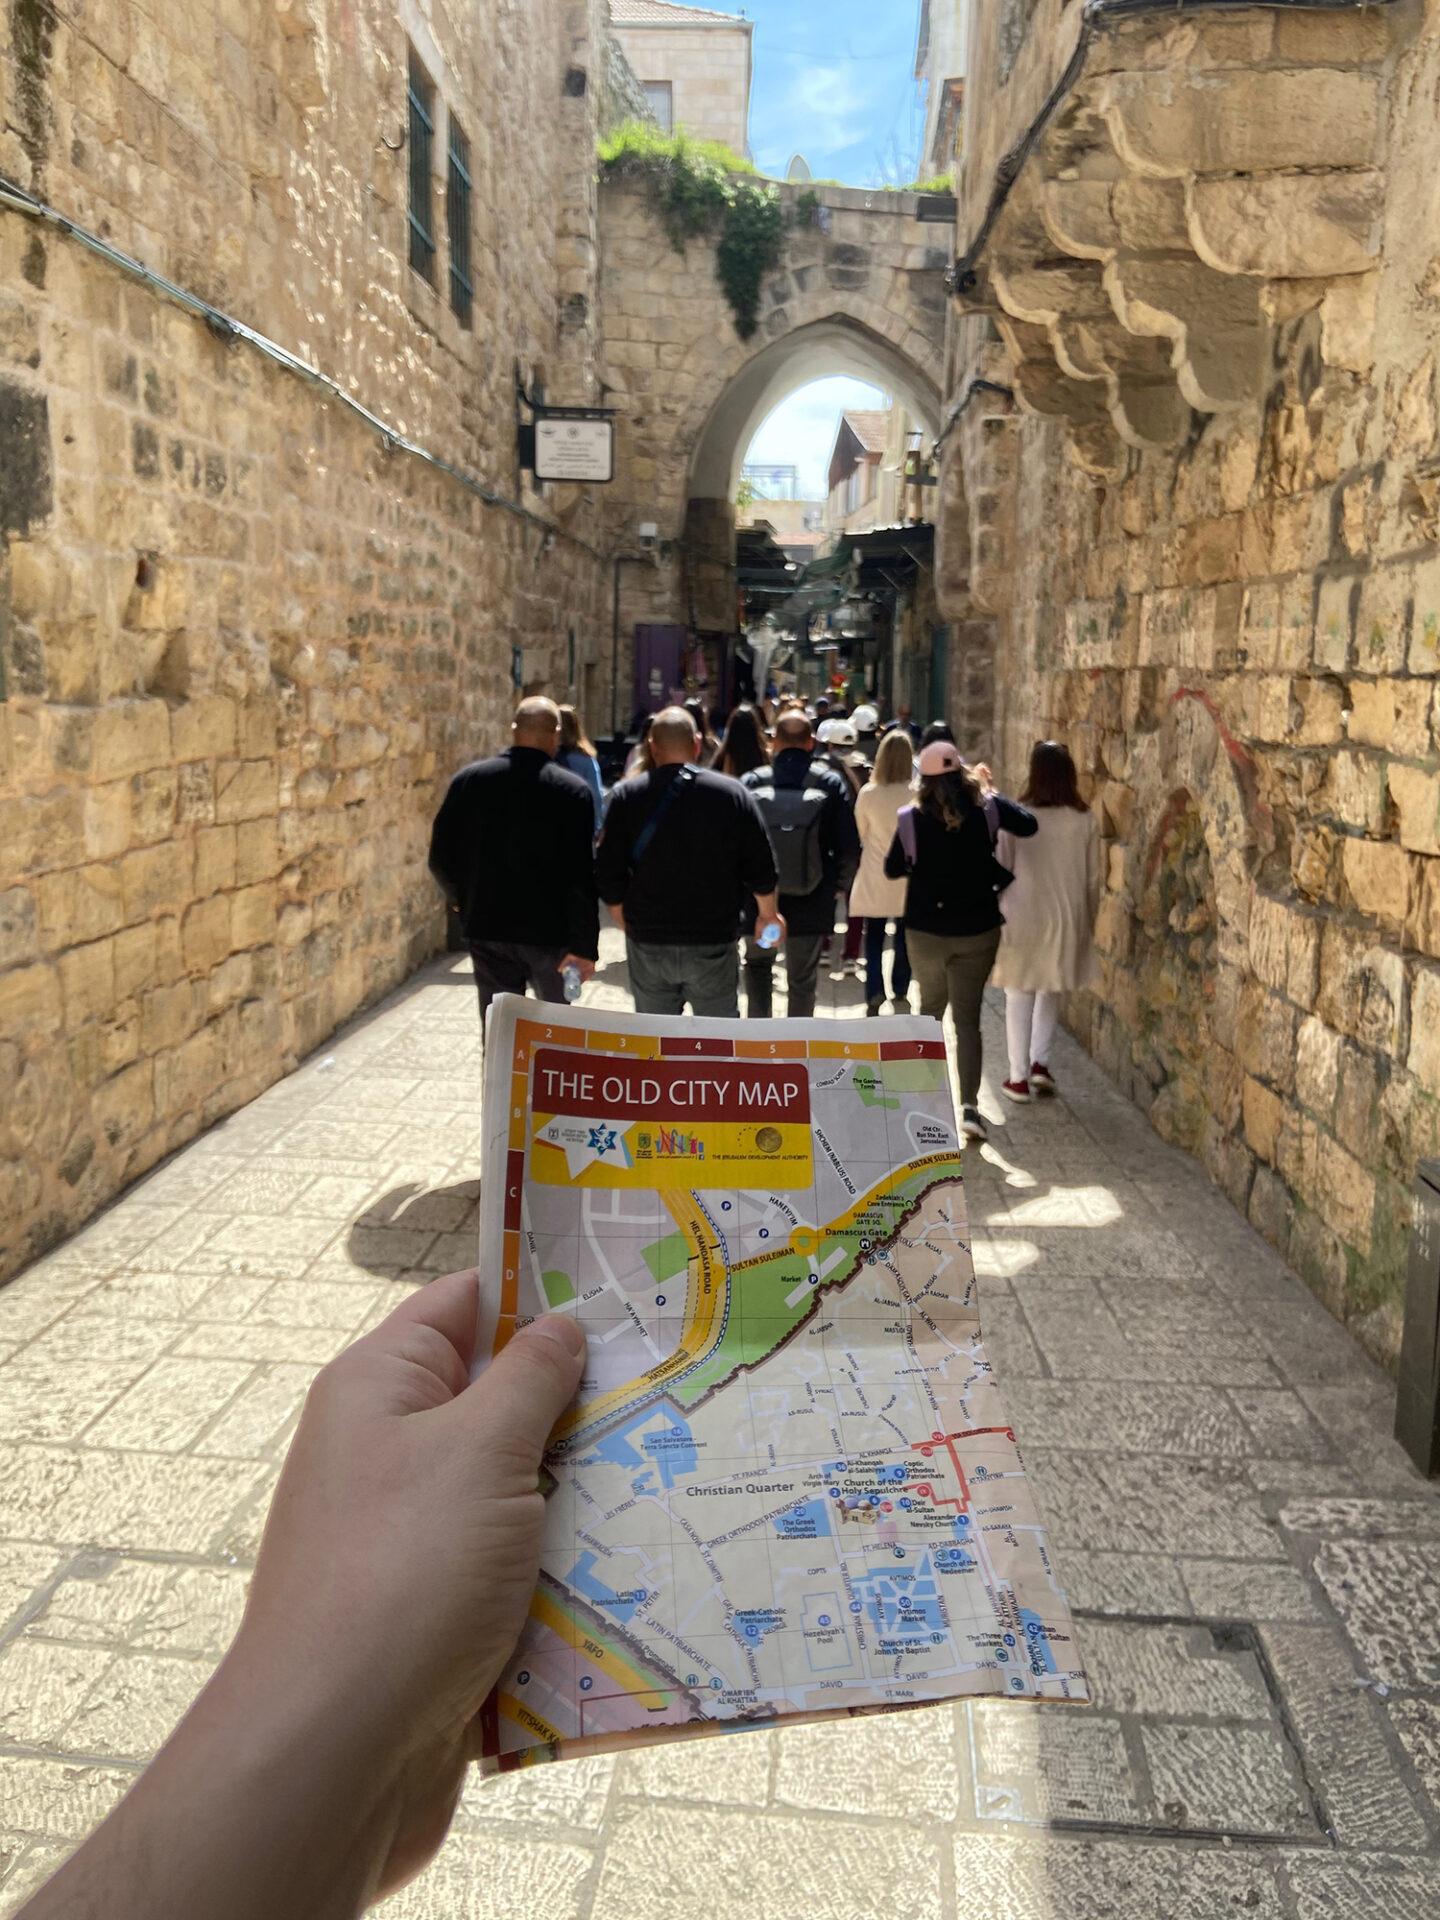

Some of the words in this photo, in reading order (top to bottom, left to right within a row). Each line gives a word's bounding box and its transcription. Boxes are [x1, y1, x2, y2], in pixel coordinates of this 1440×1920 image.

[545, 1028, 552, 1038] 2
[620, 1038, 626, 1047] 3
[695, 1041, 702, 1051] 4
[769, 1044, 776, 1054] 5
[844, 1045, 850, 1054] 6
[918, 1045, 923, 1053] 7
[516, 1050, 524, 1060] A
[542, 1069, 594, 1100] THE
[602, 1077, 660, 1105] OLD
[668, 1080, 730, 1105] CITY
[738, 1082, 799, 1107] MAP
[514, 1107, 521, 1118] B
[908, 1157, 933, 1171] SULTAN
[842, 1174, 857, 1194] ROAD
[510, 1186, 517, 1198] C
[690, 1220, 699, 1235] HEL
[870, 1229, 888, 1237] Gate
[526, 1231, 537, 1254] DANIEL
[697, 1234, 710, 1270] HANDASA
[731, 1257, 759, 1272] SULTAN
[759, 1247, 795, 1264] SULEIMAN
[506, 1269, 513, 1280] D
[885, 1262, 905, 1290] DAMASCUS
[703, 1270, 711, 1294] ROAD
[583, 1286, 603, 1301] ELISHA
[515, 1317, 535, 1330] ELISHA
[637, 1323, 649, 1338] HET
[570, 1458, 593, 1466] Gate
[742, 1468, 768, 1478] FRANCIS
[823, 1479, 840, 1487] Mary
[877, 1478, 887, 1486] of
[888, 1478, 903, 1486] the
[686, 1485, 743, 1497] Christian
[745, 1483, 795, 1494] Quarter
[842, 1487, 862, 1495] Holy
[864, 1485, 909, 1494] Sepulchre
[707, 1535, 727, 1548] GREEK
[728, 1518, 764, 1539] ORTHODOX
[764, 1495, 810, 1521] PATRIARCHATE
[933, 1561, 957, 1569] Church
[958, 1560, 968, 1568] of
[807, 1567, 827, 1575] COPTS
[642, 1590, 660, 1609] PETER
[735, 1607, 787, 1616] Greek-Catholic
[937, 1595, 950, 1628] MURISTAN
[1005, 1621, 1014, 1630] AL
[855, 1615, 867, 1650] CHRISTIAN
[1017, 1629, 1026, 1637] AL
[646, 1619, 665, 1638] LATIN
[664, 1631, 712, 1672] PATRIARCHATE
[817, 1637, 833, 1645] Pool
[878, 1640, 903, 1648] Church
[583, 1639, 604, 1659] YAFO
[874, 1647, 892, 1656] John
[891, 1647, 904, 1655] the
[905, 1646, 931, 1655] Baptist
[1031, 1635, 1046, 1663] SULTAN
[975, 1661, 998, 1670] DAVID
[906, 1672, 928, 1681] DAVID
[820, 1681, 843, 1689] DAVID
[517, 1708, 548, 1738] YITSHAK
